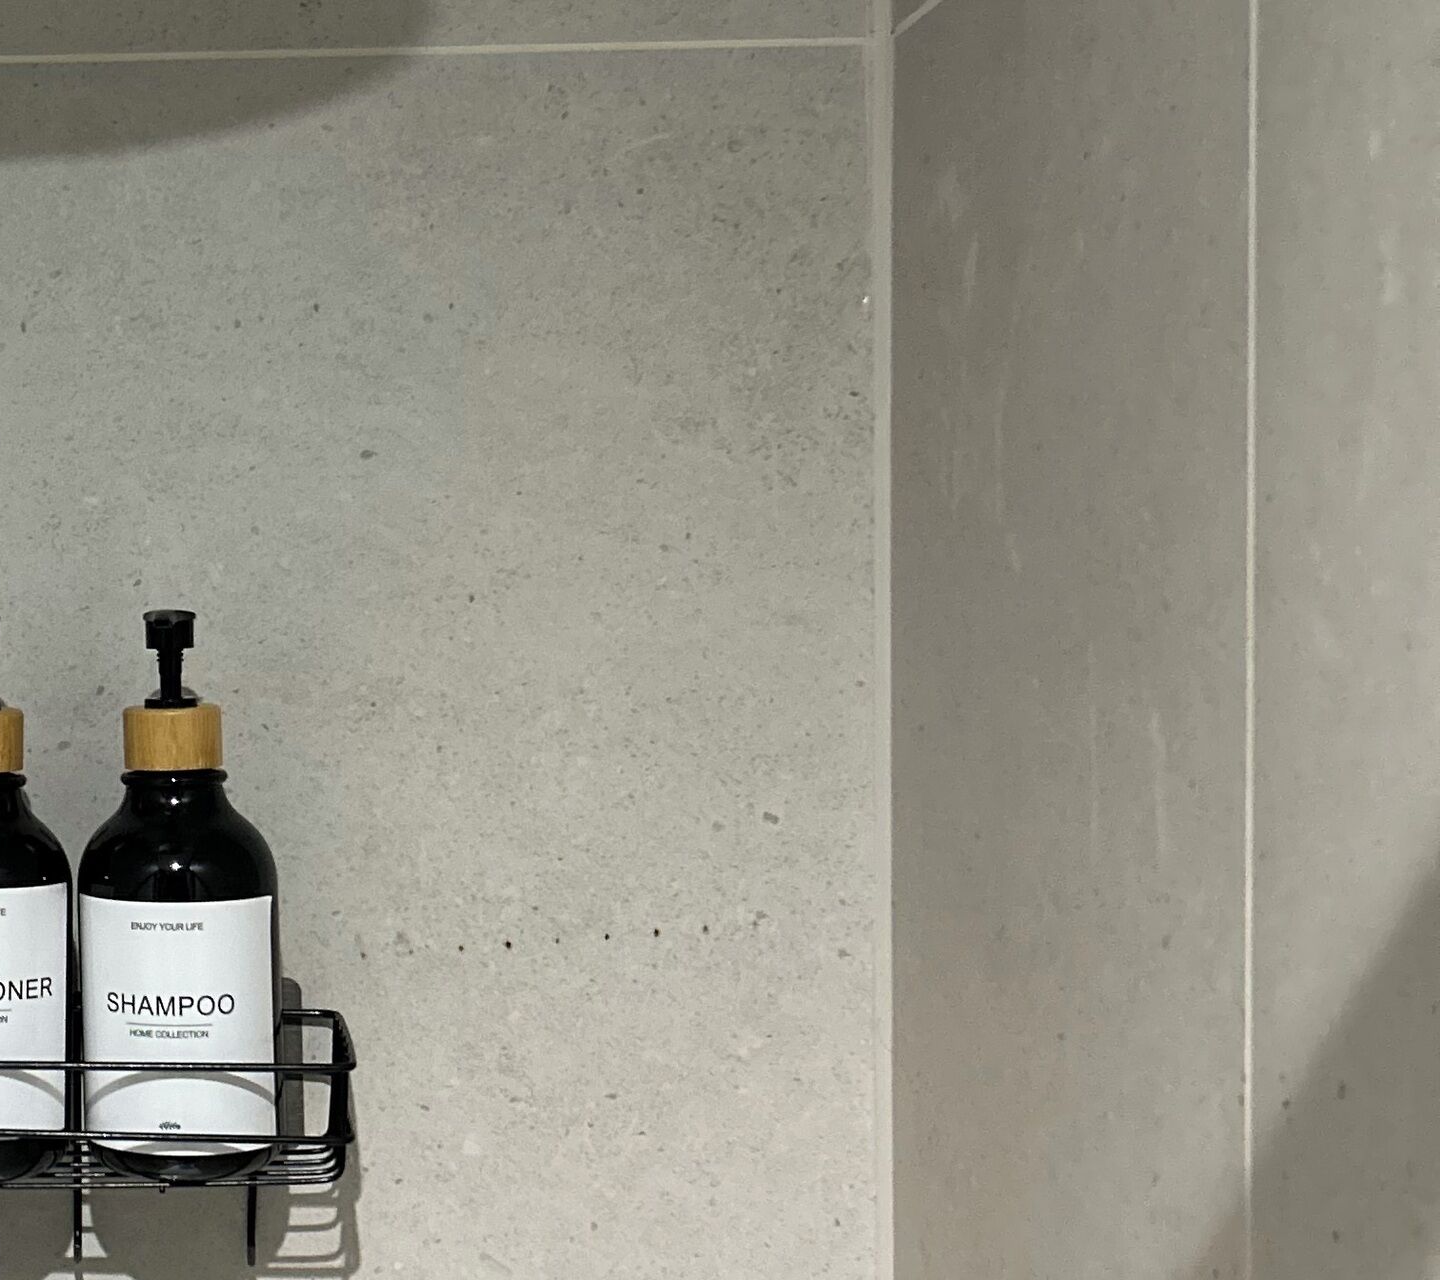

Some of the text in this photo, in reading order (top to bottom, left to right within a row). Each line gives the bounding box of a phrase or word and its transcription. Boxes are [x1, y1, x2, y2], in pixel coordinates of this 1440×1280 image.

[130, 921, 204, 932] ENJOY YOUR LIFE
[106, 991, 236, 1017] SHAMPOO
[129, 1028, 209, 1039] HOME COLLECTION
